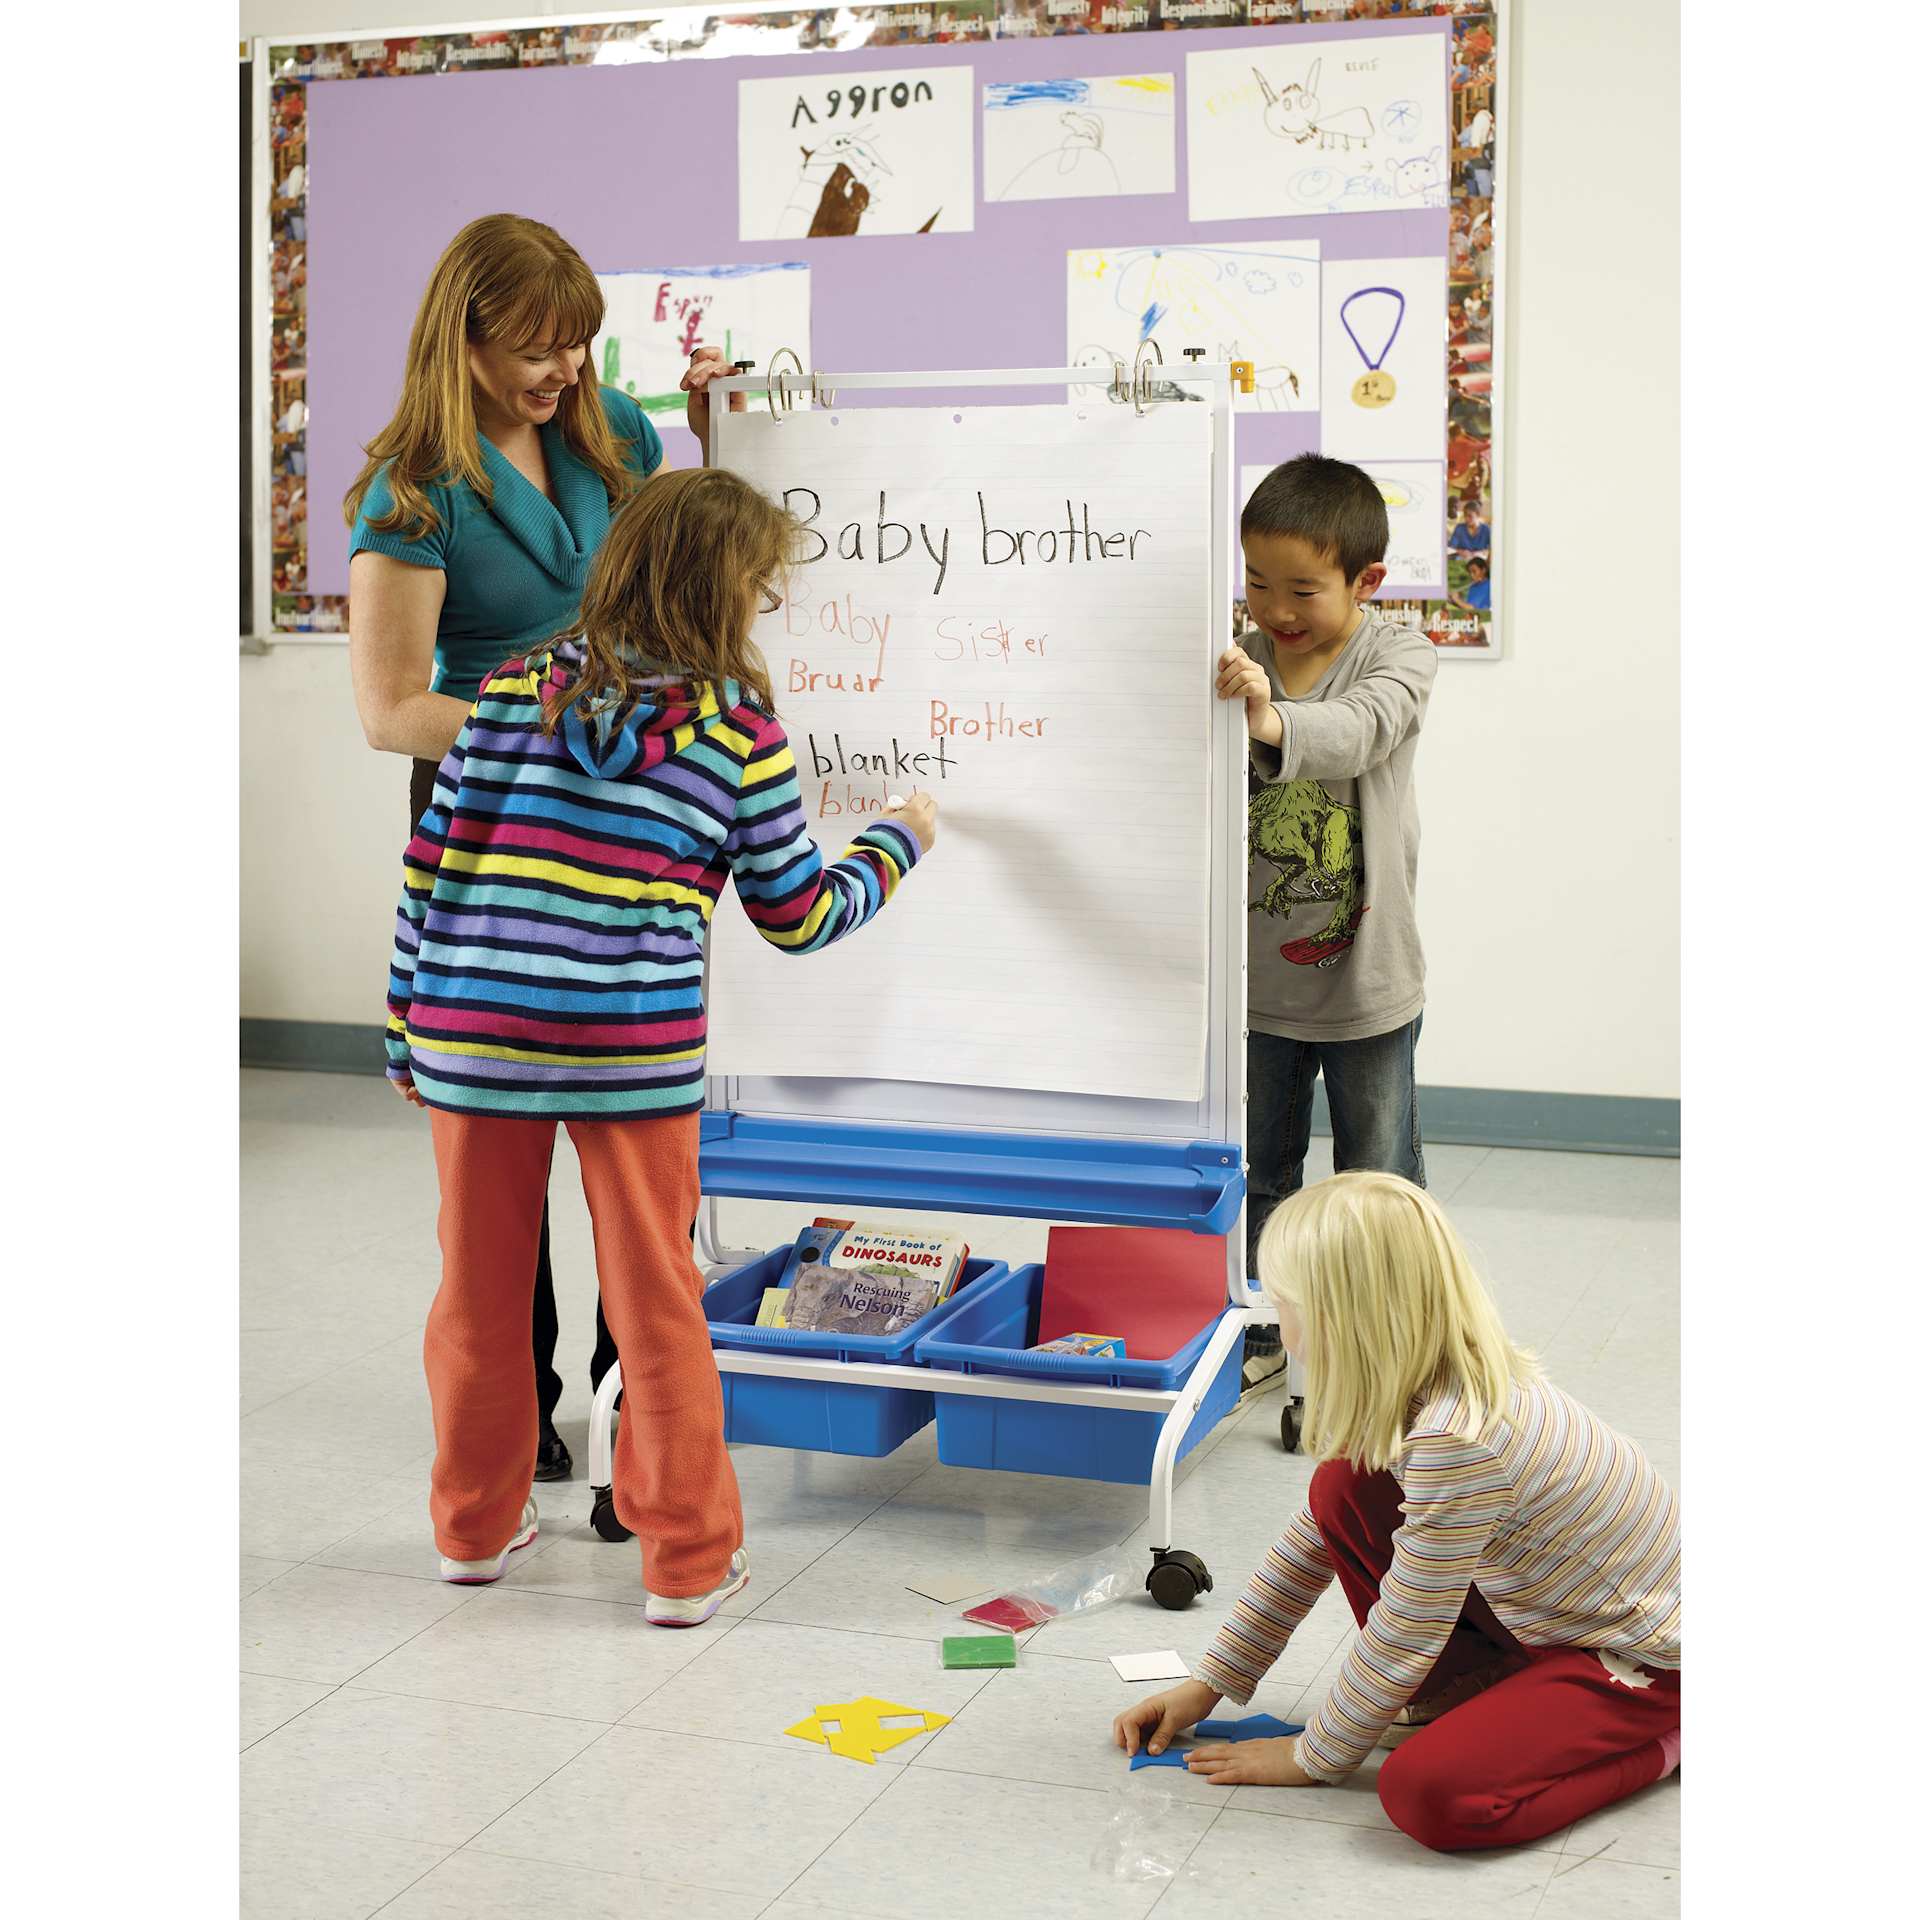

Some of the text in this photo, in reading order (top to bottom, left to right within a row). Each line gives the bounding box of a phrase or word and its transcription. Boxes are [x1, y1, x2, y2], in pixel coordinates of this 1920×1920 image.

[791, 81, 933, 128] Aggron
[783, 487, 1152, 595] Baby brother
[783, 575, 891, 679] Baby
[930, 699, 1049, 741] Brother
[809, 733, 959, 779] blanket
[819, 779, 918, 818] blan
[842, 1245, 944, 1268] DINOSAURS
[854, 1235, 942, 1252] My First Book of
[839, 1294, 905, 1317] Nelson
[853, 1282, 912, 1303] Rescuing
